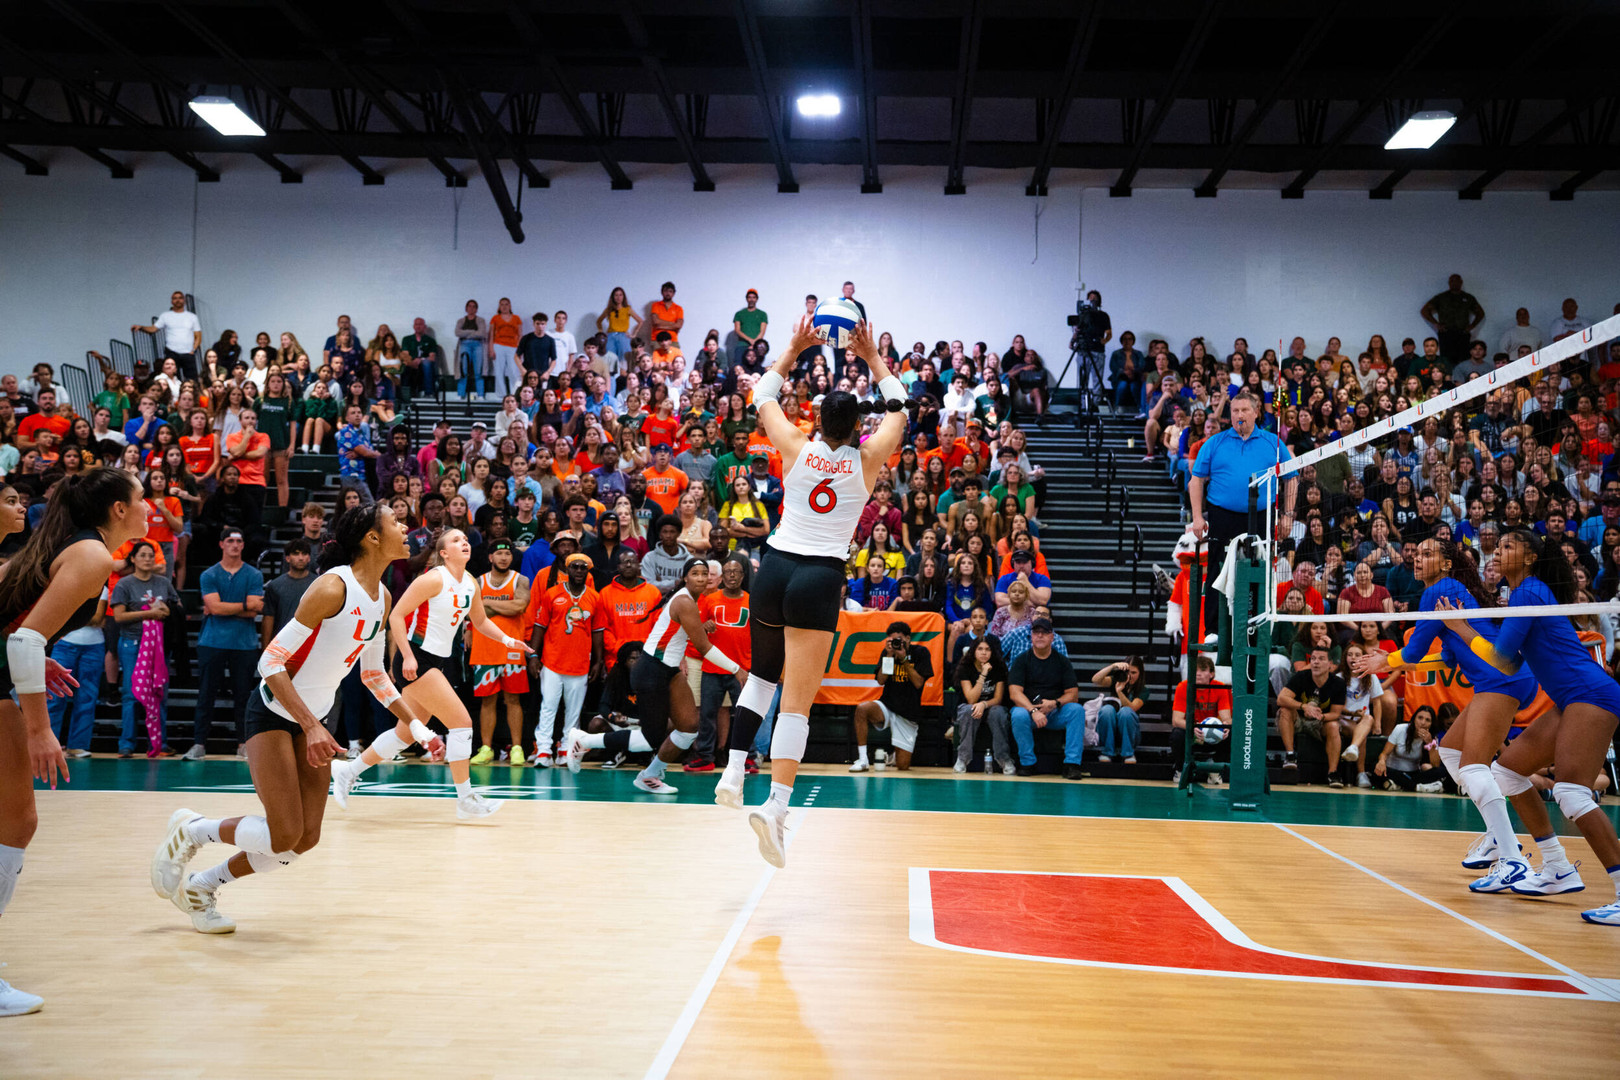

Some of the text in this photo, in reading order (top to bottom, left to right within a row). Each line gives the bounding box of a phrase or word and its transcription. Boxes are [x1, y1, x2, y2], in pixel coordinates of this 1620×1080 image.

[804, 453, 853, 474] RODRIGUEZ
[646, 477, 676, 488] MIAMI
[808, 478, 838, 514] 6
[615, 601, 647, 612] MIAMI
[450, 609, 463, 627] 5
[343, 643, 366, 668] 4
[1242, 708, 1253, 771] sports imports
